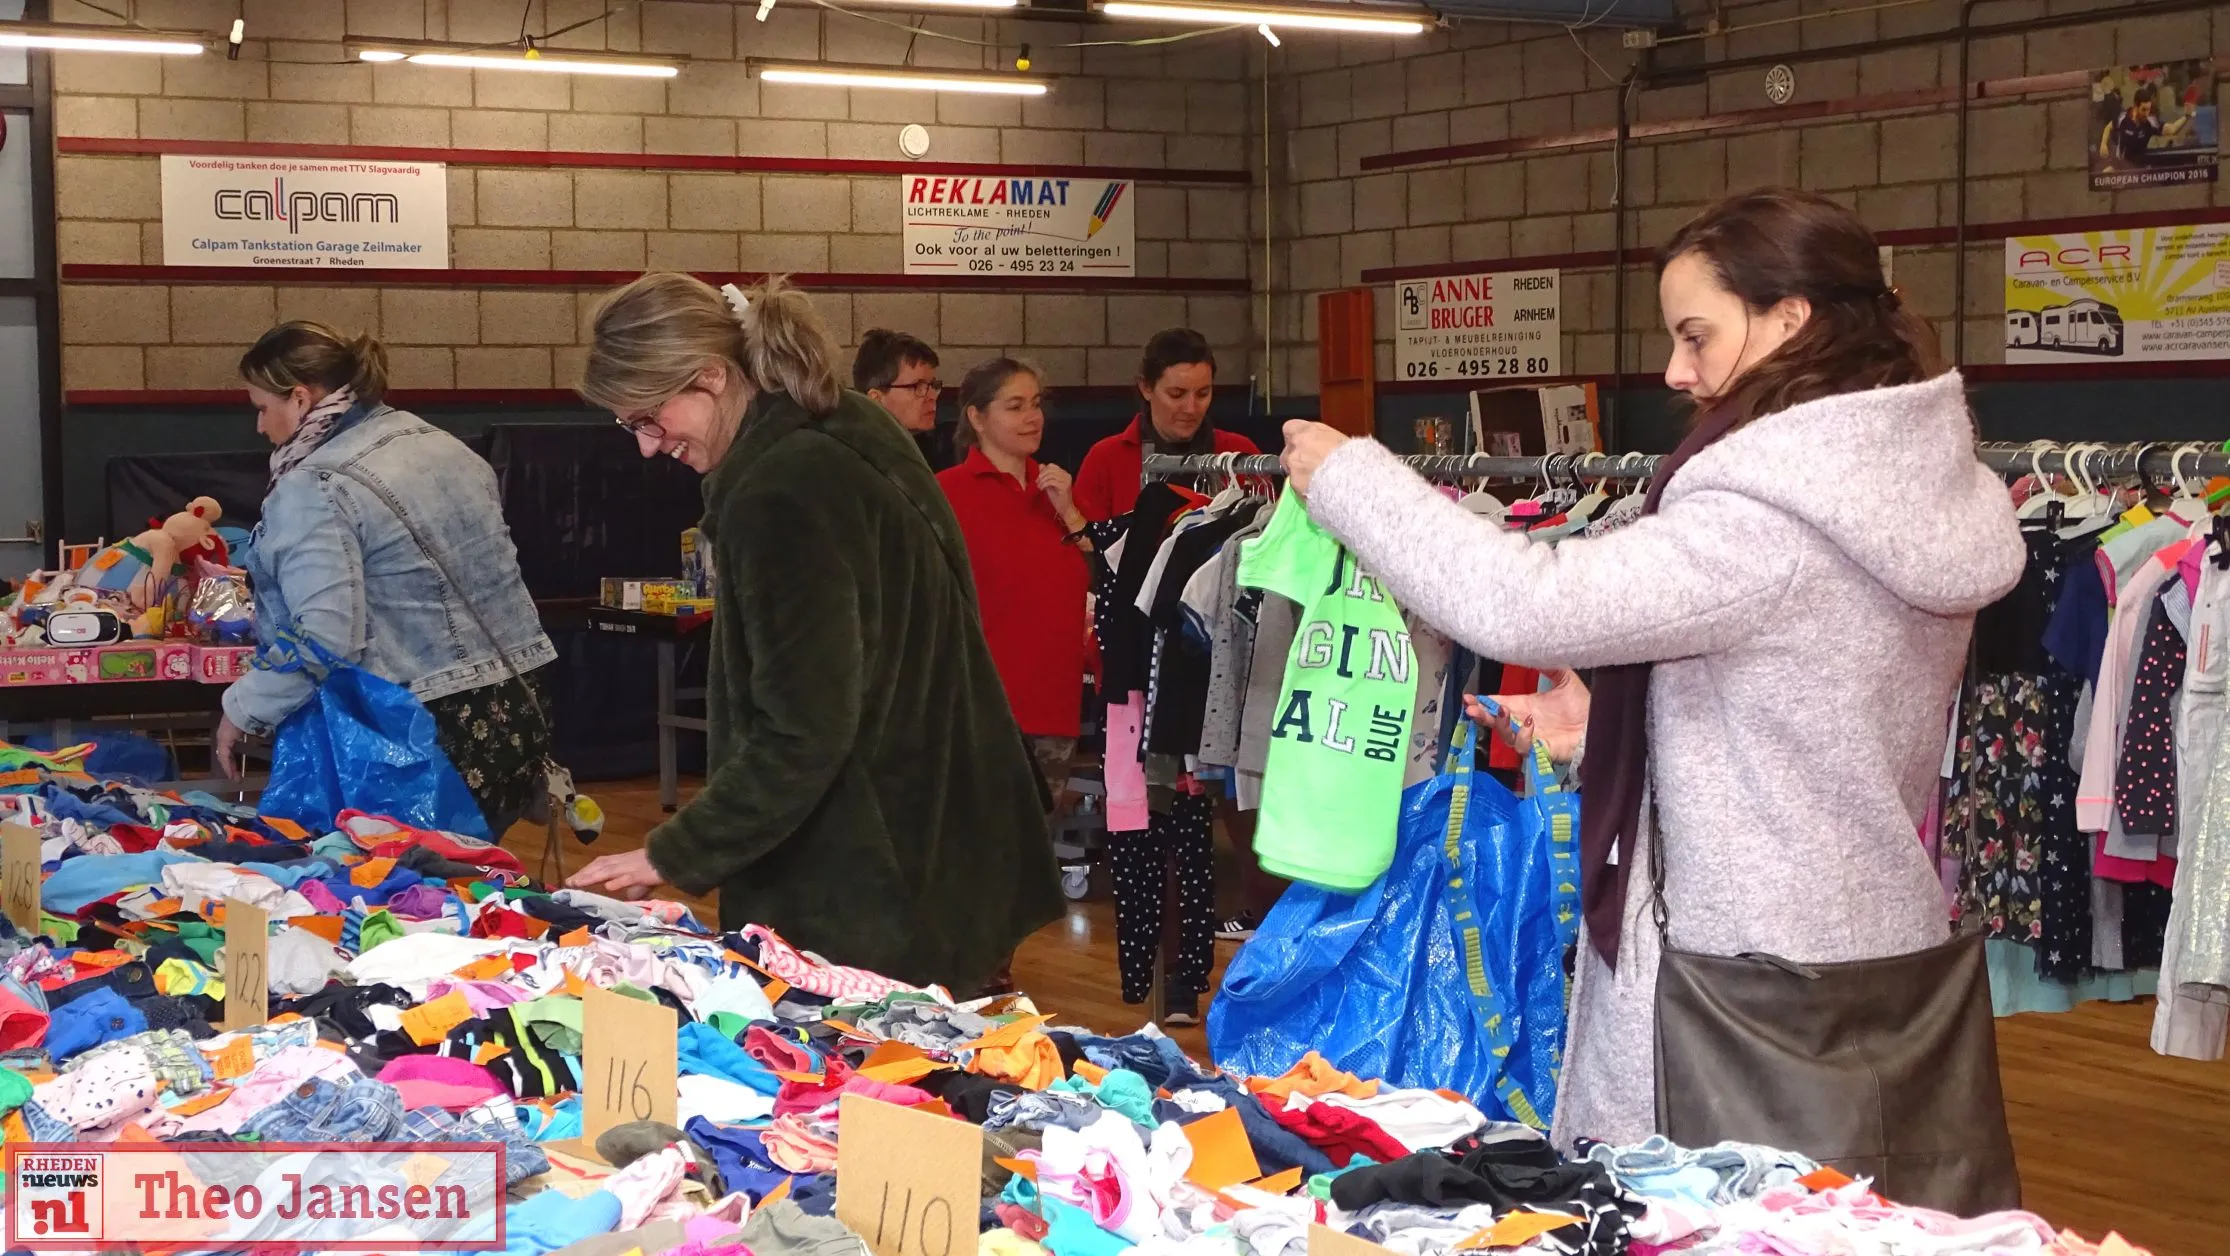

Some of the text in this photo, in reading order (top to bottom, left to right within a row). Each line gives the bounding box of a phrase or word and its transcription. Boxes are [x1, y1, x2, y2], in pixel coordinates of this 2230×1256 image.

[190, 160, 234, 170] Voordelig
[236, 161, 267, 170] tanken
[270, 162, 286, 170] doe
[289, 163, 298, 173] je
[330, 165, 348, 173] met
[348, 165, 366, 173] TTV
[369, 165, 420, 176] Slagvaardig
[2094, 174, 2138, 186] EUROPEAN
[2141, 171, 2186, 182] CHAMPION
[909, 178, 1070, 206] REKLAMAT
[215, 177, 398, 234] calpam
[908, 207, 990, 218] LICHTREKLAME
[1006, 209, 1050, 218] RHEDEN
[953, 222, 1032, 244] To the point!
[192, 238, 422, 254] Calpam Tankstation Garage Zeilmaker
[915, 244, 942, 255] Ook
[947, 245, 980, 256] voor
[985, 244, 996, 256] al
[1002, 246, 1020, 256] uw
[1026, 245, 1111, 259] beletteringen
[253, 256, 364, 266] Groenestraat 7 Rheden
[2020, 245, 2131, 268] ACR
[968, 260, 993, 272] 026
[1010, 260, 1034, 272] 495
[1039, 260, 1054, 272] 23
[1060, 260, 1074, 272] 24
[1513, 276, 1553, 291] RHEDEN
[2013, 278, 2048, 288] Caravan-
[2051, 278, 2061, 286] en
[2063, 274, 2124, 288] Camperservice
[1431, 277, 1493, 303] ANNE
[1431, 306, 1494, 329] BRUGER
[1514, 308, 1555, 322] ARNHEM
[2186, 306, 2197, 314] AV
[1454, 331, 1542, 344] MEUBELREINIGING
[1430, 346, 1518, 358] VLOERONDERHOUD
[1407, 362, 1438, 377] 026
[1458, 360, 1490, 376] 495
[1498, 358, 1519, 374] 28
[1526, 358, 1548, 374] 80
[1298, 620, 1411, 684] GIN
[1272, 689, 1354, 755] AL
[1364, 704, 1407, 763] BLUE
[234, 951, 261, 1013] 122
[607, 1056, 652, 1122] 116
[876, 1181, 952, 1256] 110
